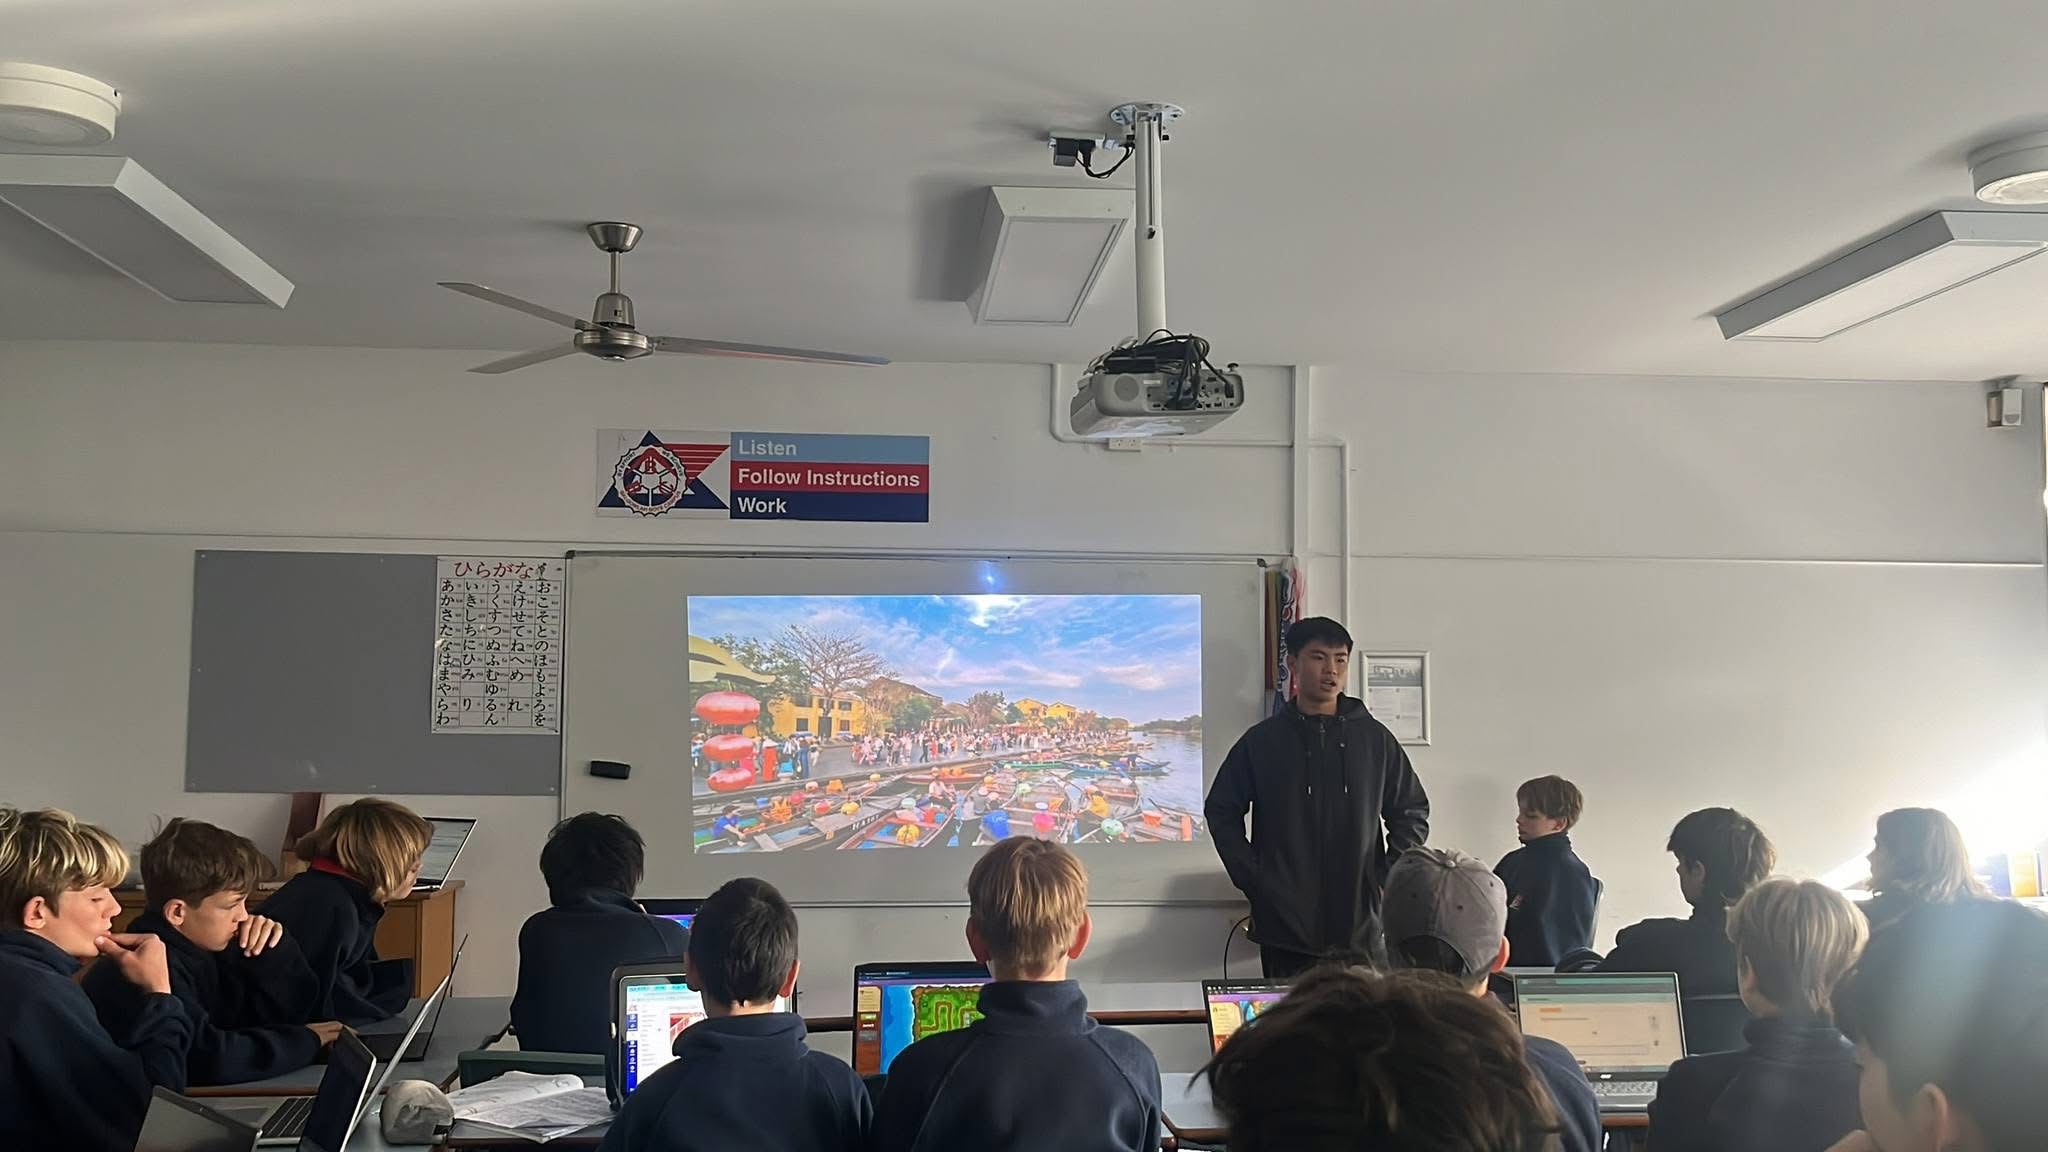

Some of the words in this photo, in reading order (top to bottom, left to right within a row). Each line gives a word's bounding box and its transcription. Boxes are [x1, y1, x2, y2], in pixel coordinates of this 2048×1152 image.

[739, 439, 797, 456] Listen
[738, 468, 801, 485] Follow
[807, 469, 920, 487] Instructions
[737, 496, 787, 513] Work
[454, 561, 534, 579] ひらがな
[442, 580, 454, 592] あ
[466, 581, 478, 590] い
[492, 580, 500, 594] う
[514, 581, 526, 594] え
[537, 582, 551, 594] お
[441, 595, 454, 606] か
[466, 593, 476, 608] き
[492, 595, 499, 608] く
[513, 595, 526, 608] け
[538, 597, 549, 608] こ
[442, 609, 452, 621] さ
[466, 609, 476, 622] し
[488, 608, 502, 623] す
[512, 611, 526, 623] せ
[537, 611, 549, 624] そ
[440, 624, 453, 636] た
[465, 624, 477, 637] ち
[488, 626, 501, 636] つ
[513, 625, 525, 637] て
[537, 625, 547, 638] と
[464, 640, 475, 651] に
[487, 639, 501, 651] ぬ
[511, 639, 525, 652] ね
[535, 640, 549, 651] の
[439, 653, 451, 666] は
[463, 653, 475, 666] ひ
[486, 654, 500, 666] ふ
[510, 656, 525, 664] へ
[534, 654, 548, 667] ほ
[439, 667, 449, 681] ま
[462, 668, 475, 680] み
[486, 668, 500, 681] む
[510, 669, 524, 681] め
[536, 668, 546, 682] も
[437, 683, 451, 696] や
[485, 683, 499, 696] ゆ
[535, 683, 545, 697] よ
[438, 698, 448, 711] ら
[463, 698, 471, 712] り
[486, 699, 497, 711] る
[508, 699, 523, 711] れ
[534, 699, 546, 712] ろ
[436, 712, 450, 725] わ
[485, 713, 499, 725] ん
[534, 713, 546, 727] を
